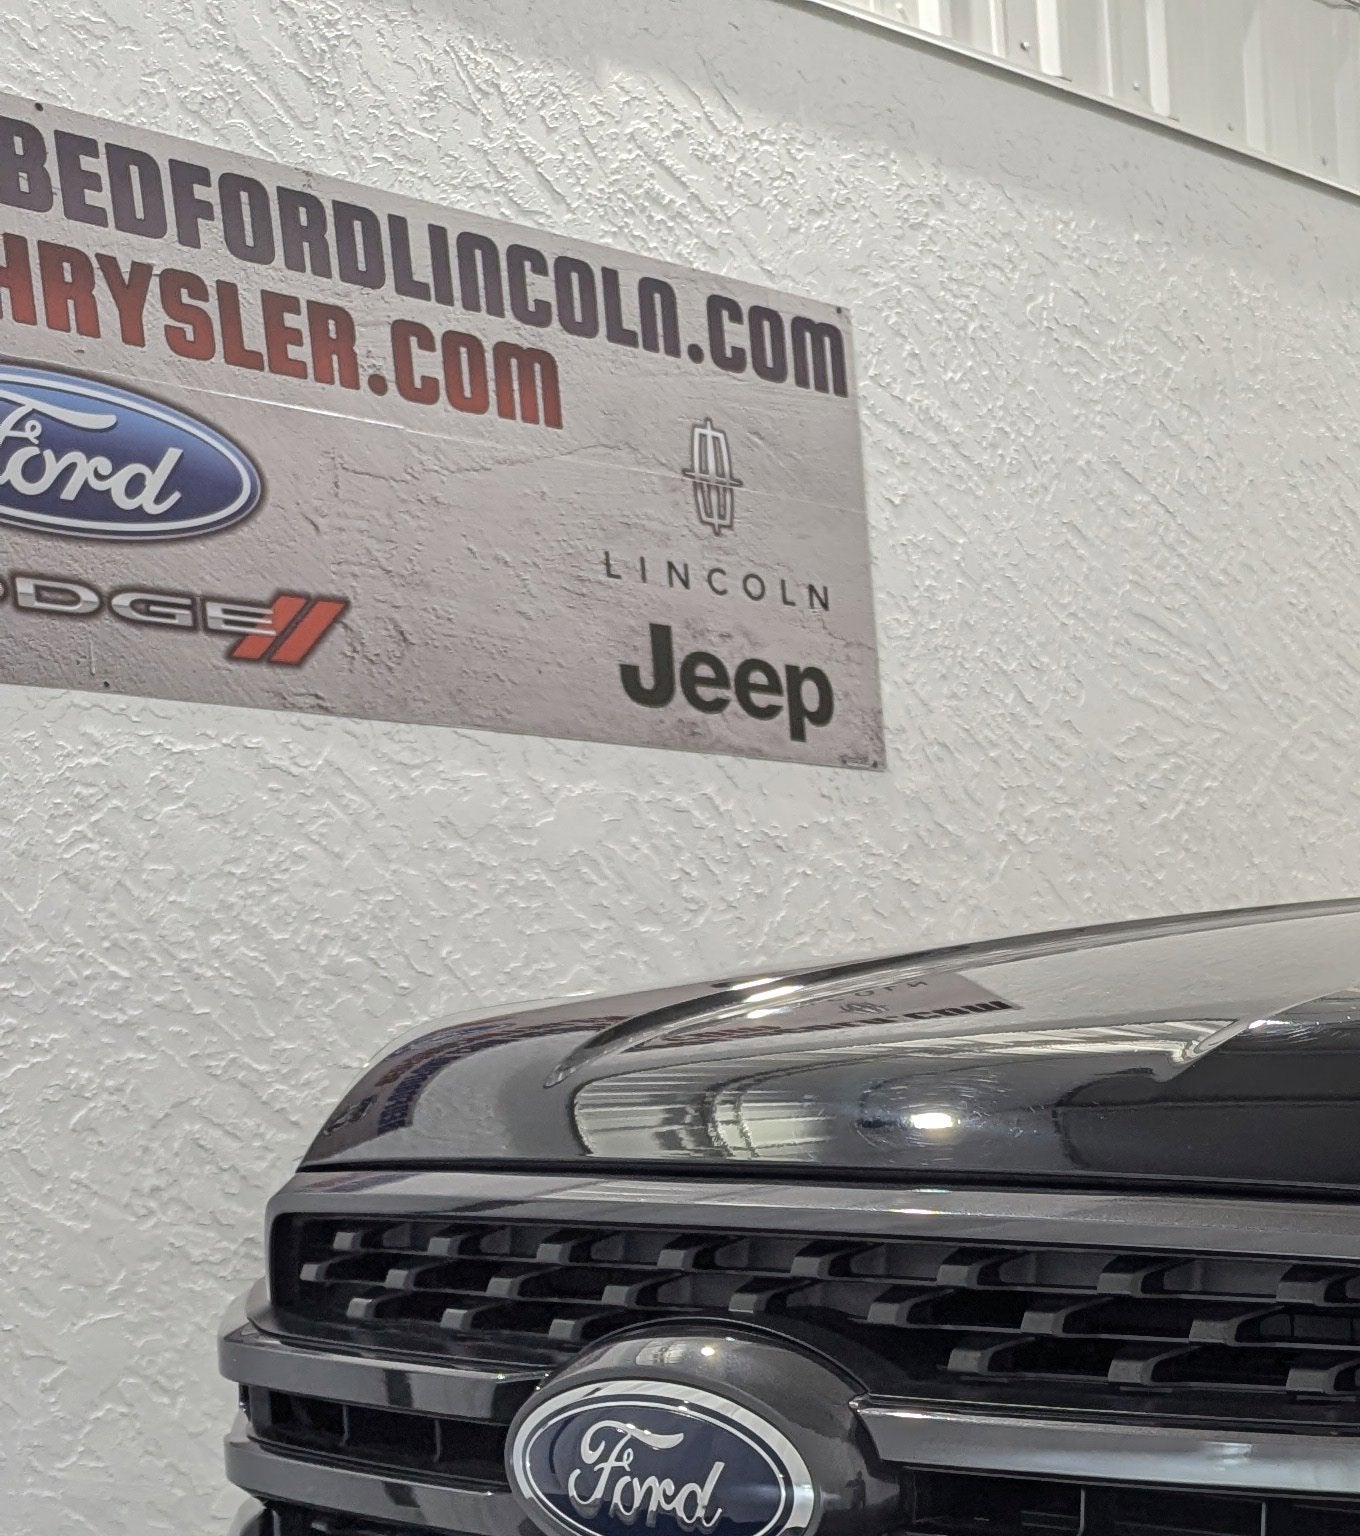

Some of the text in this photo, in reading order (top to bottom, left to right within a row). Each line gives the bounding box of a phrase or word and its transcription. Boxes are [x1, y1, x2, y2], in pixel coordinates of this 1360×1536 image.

[604, 551, 830, 612] LINCOLN
[619, 623, 834, 743] Jeep
[568, 1420, 724, 1527] Ford
